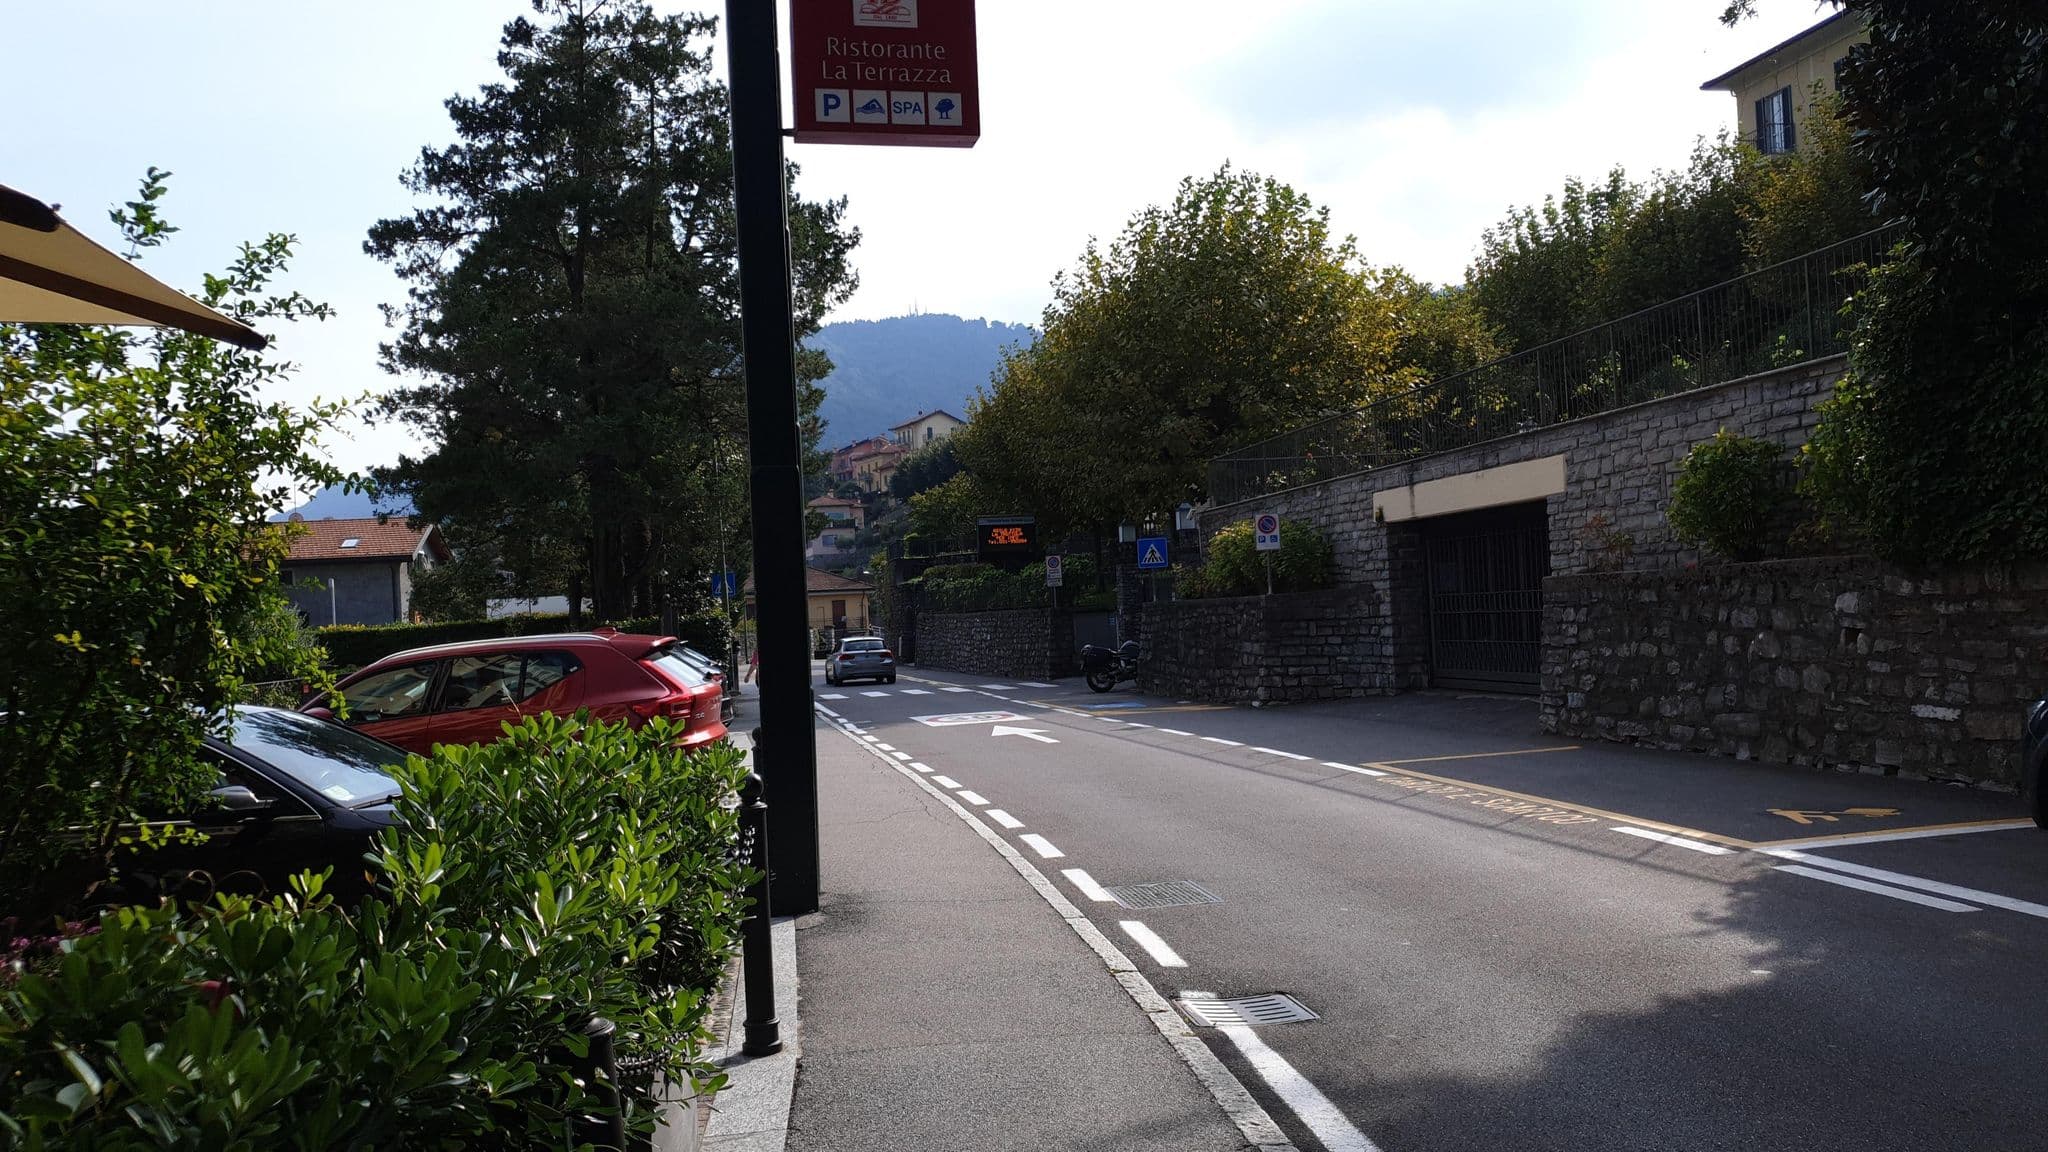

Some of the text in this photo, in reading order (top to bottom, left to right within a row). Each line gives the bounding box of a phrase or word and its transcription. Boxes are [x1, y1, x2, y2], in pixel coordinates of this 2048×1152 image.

[827, 37, 946, 60] Ristorante
[822, 60, 952, 84] La Terrazza
[823, 93, 841, 117] P
[892, 101, 923, 115] SPA
[1470, 798, 1598, 825] SCARICO
